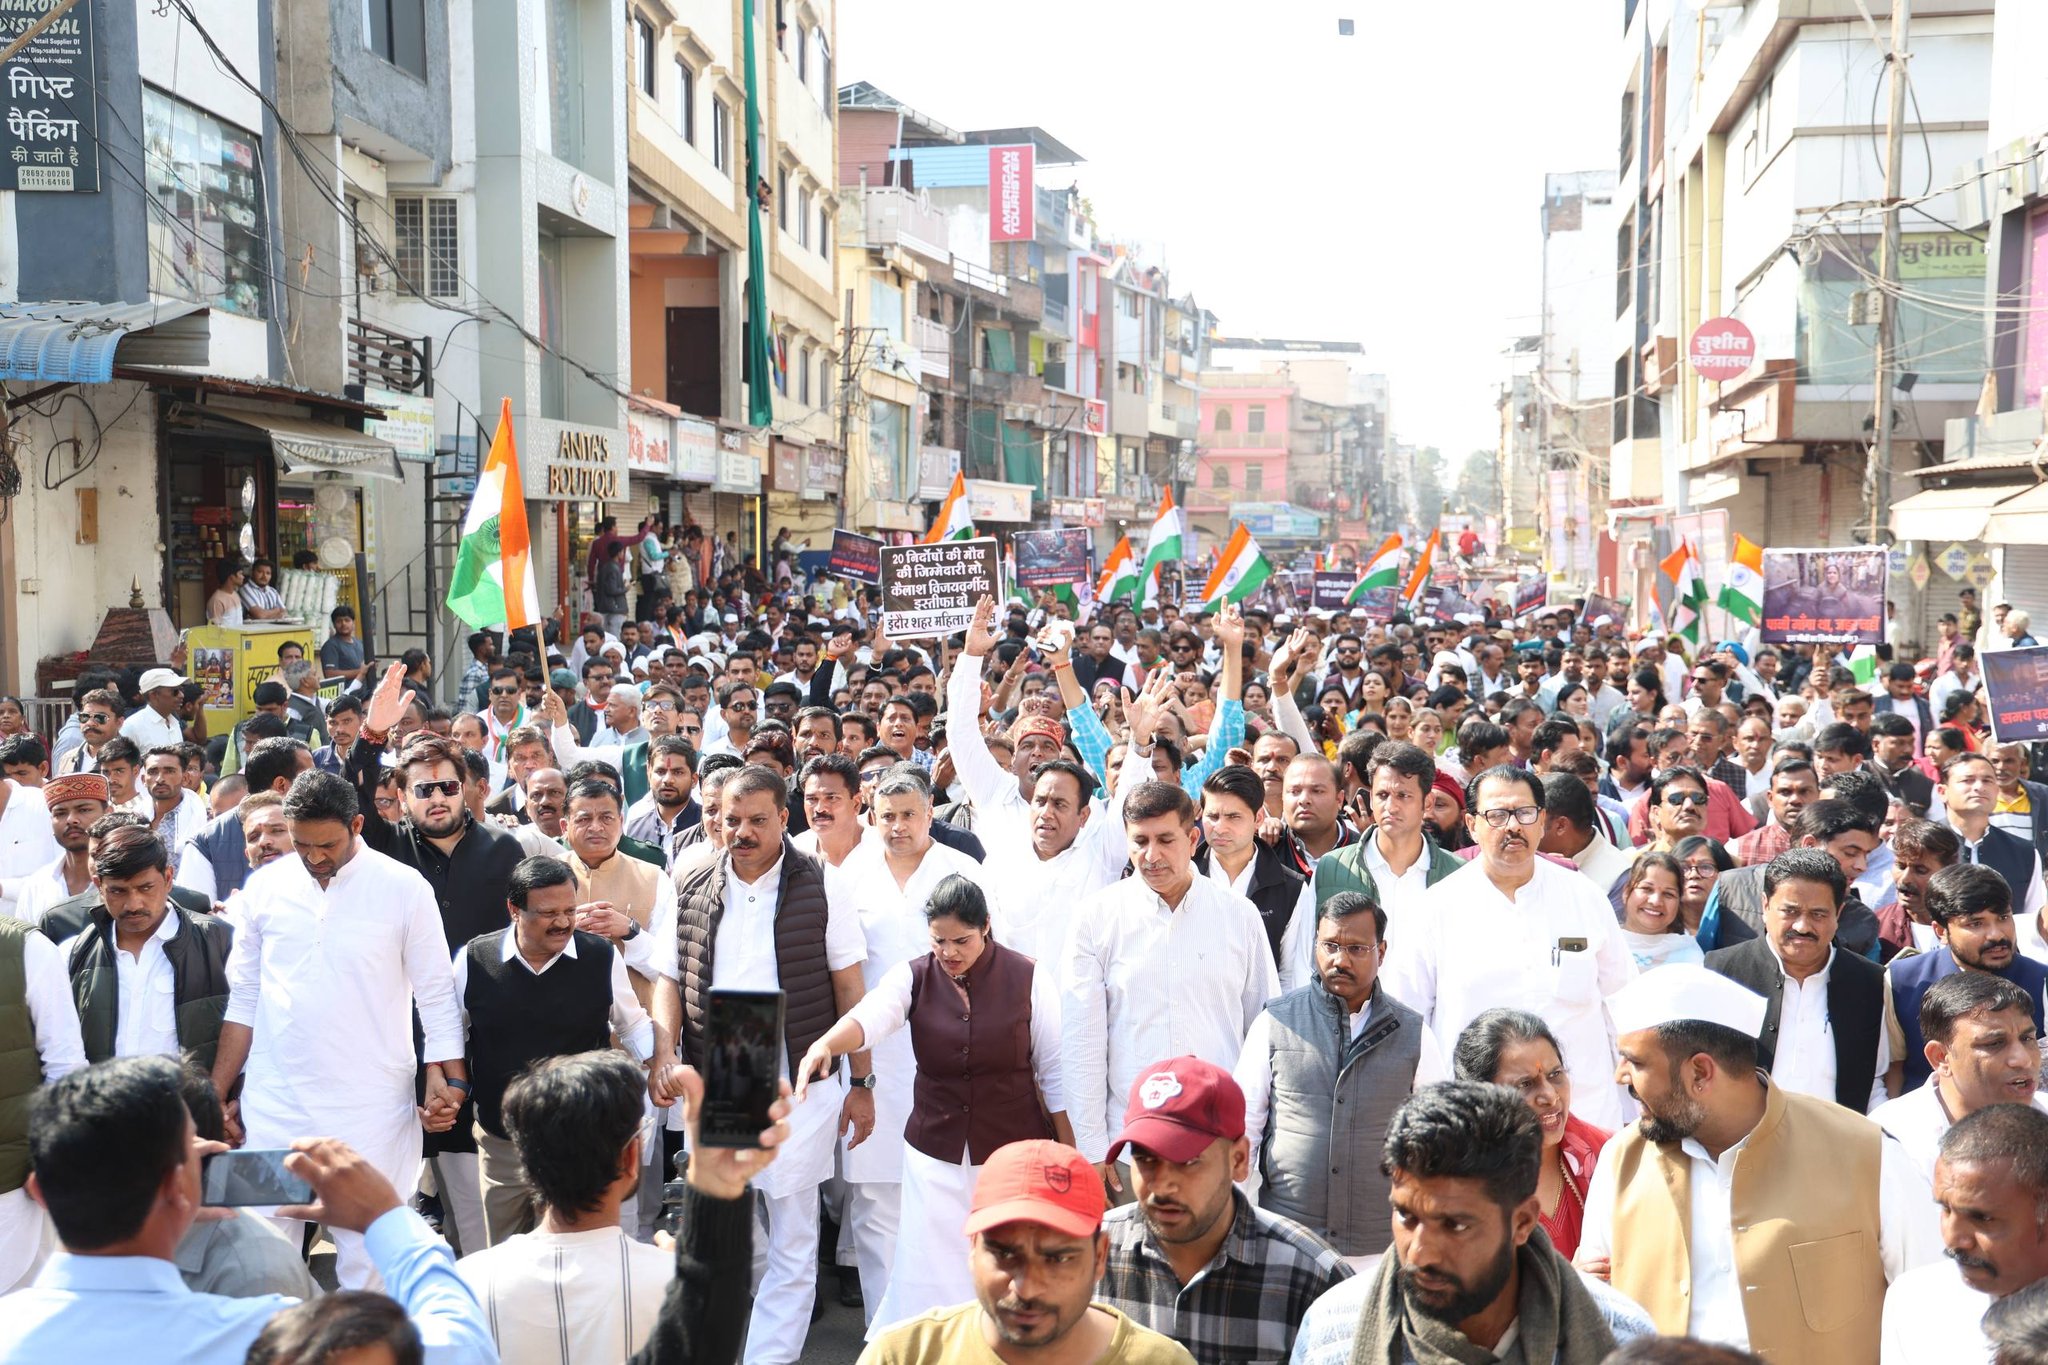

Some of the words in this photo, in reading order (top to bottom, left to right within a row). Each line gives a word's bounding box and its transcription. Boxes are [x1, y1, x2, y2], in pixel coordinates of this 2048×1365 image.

[7, 106, 80, 142] पैकिंग
[11, 146, 29, 163] की
[34, 147, 64, 164] जाती
[69, 146, 80, 166] है
[1002, 151, 1012, 235] AMERICAN
[1010, 151, 1020, 235] TOURISTER
[1697, 332, 1749, 354] सुशील
[557, 430, 609, 462] ANITA'S
[892, 554, 904, 565] 20
[905, 548, 943, 563] निर्दोषों
[946, 547, 961, 561] की
[963, 546, 985, 560] मौत
[896, 565, 912, 578] की
[914, 561, 966, 577] जिम्मेदारी
[967, 560, 986, 576] लो,
[891, 582, 927, 597] कैलाश
[928, 577, 990, 595] विजयवर्गीय
[913, 594, 955, 611] इस्तीफा
[956, 592, 968, 607] दो
[887, 614, 909, 631] इंदौर
[912, 616, 932, 629] शहर
[934, 611, 964, 627] महिला
[2000, 709, 2032, 724] समय
